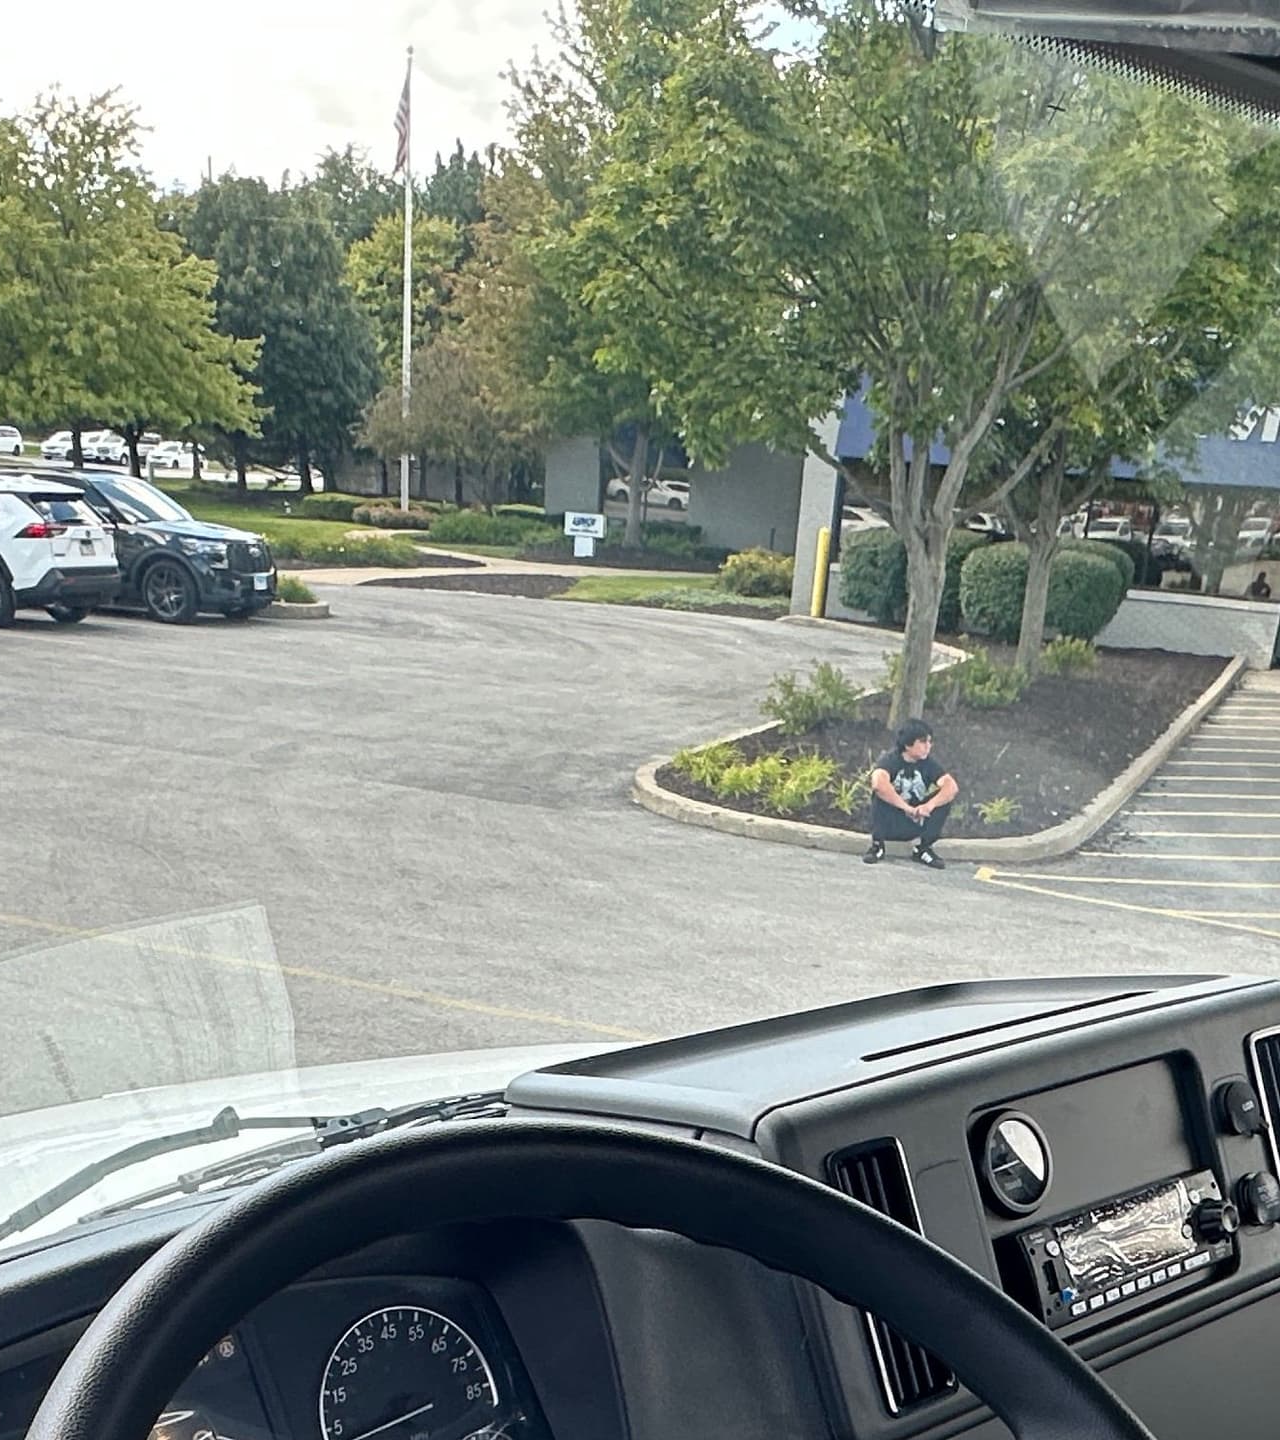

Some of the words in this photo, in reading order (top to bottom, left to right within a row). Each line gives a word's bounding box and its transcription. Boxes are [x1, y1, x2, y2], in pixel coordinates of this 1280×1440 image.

[380, 1323, 397, 1340] 45
[408, 1323, 425, 1341] 55
[357, 1335, 375, 1354] 35
[431, 1336, 447, 1354] 65
[340, 1357, 358, 1376] 25
[451, 1356, 468, 1373] 75
[332, 1386, 347, 1405] 15
[466, 1383, 482, 1400] 85
[334, 1419, 343, 1436] 5
